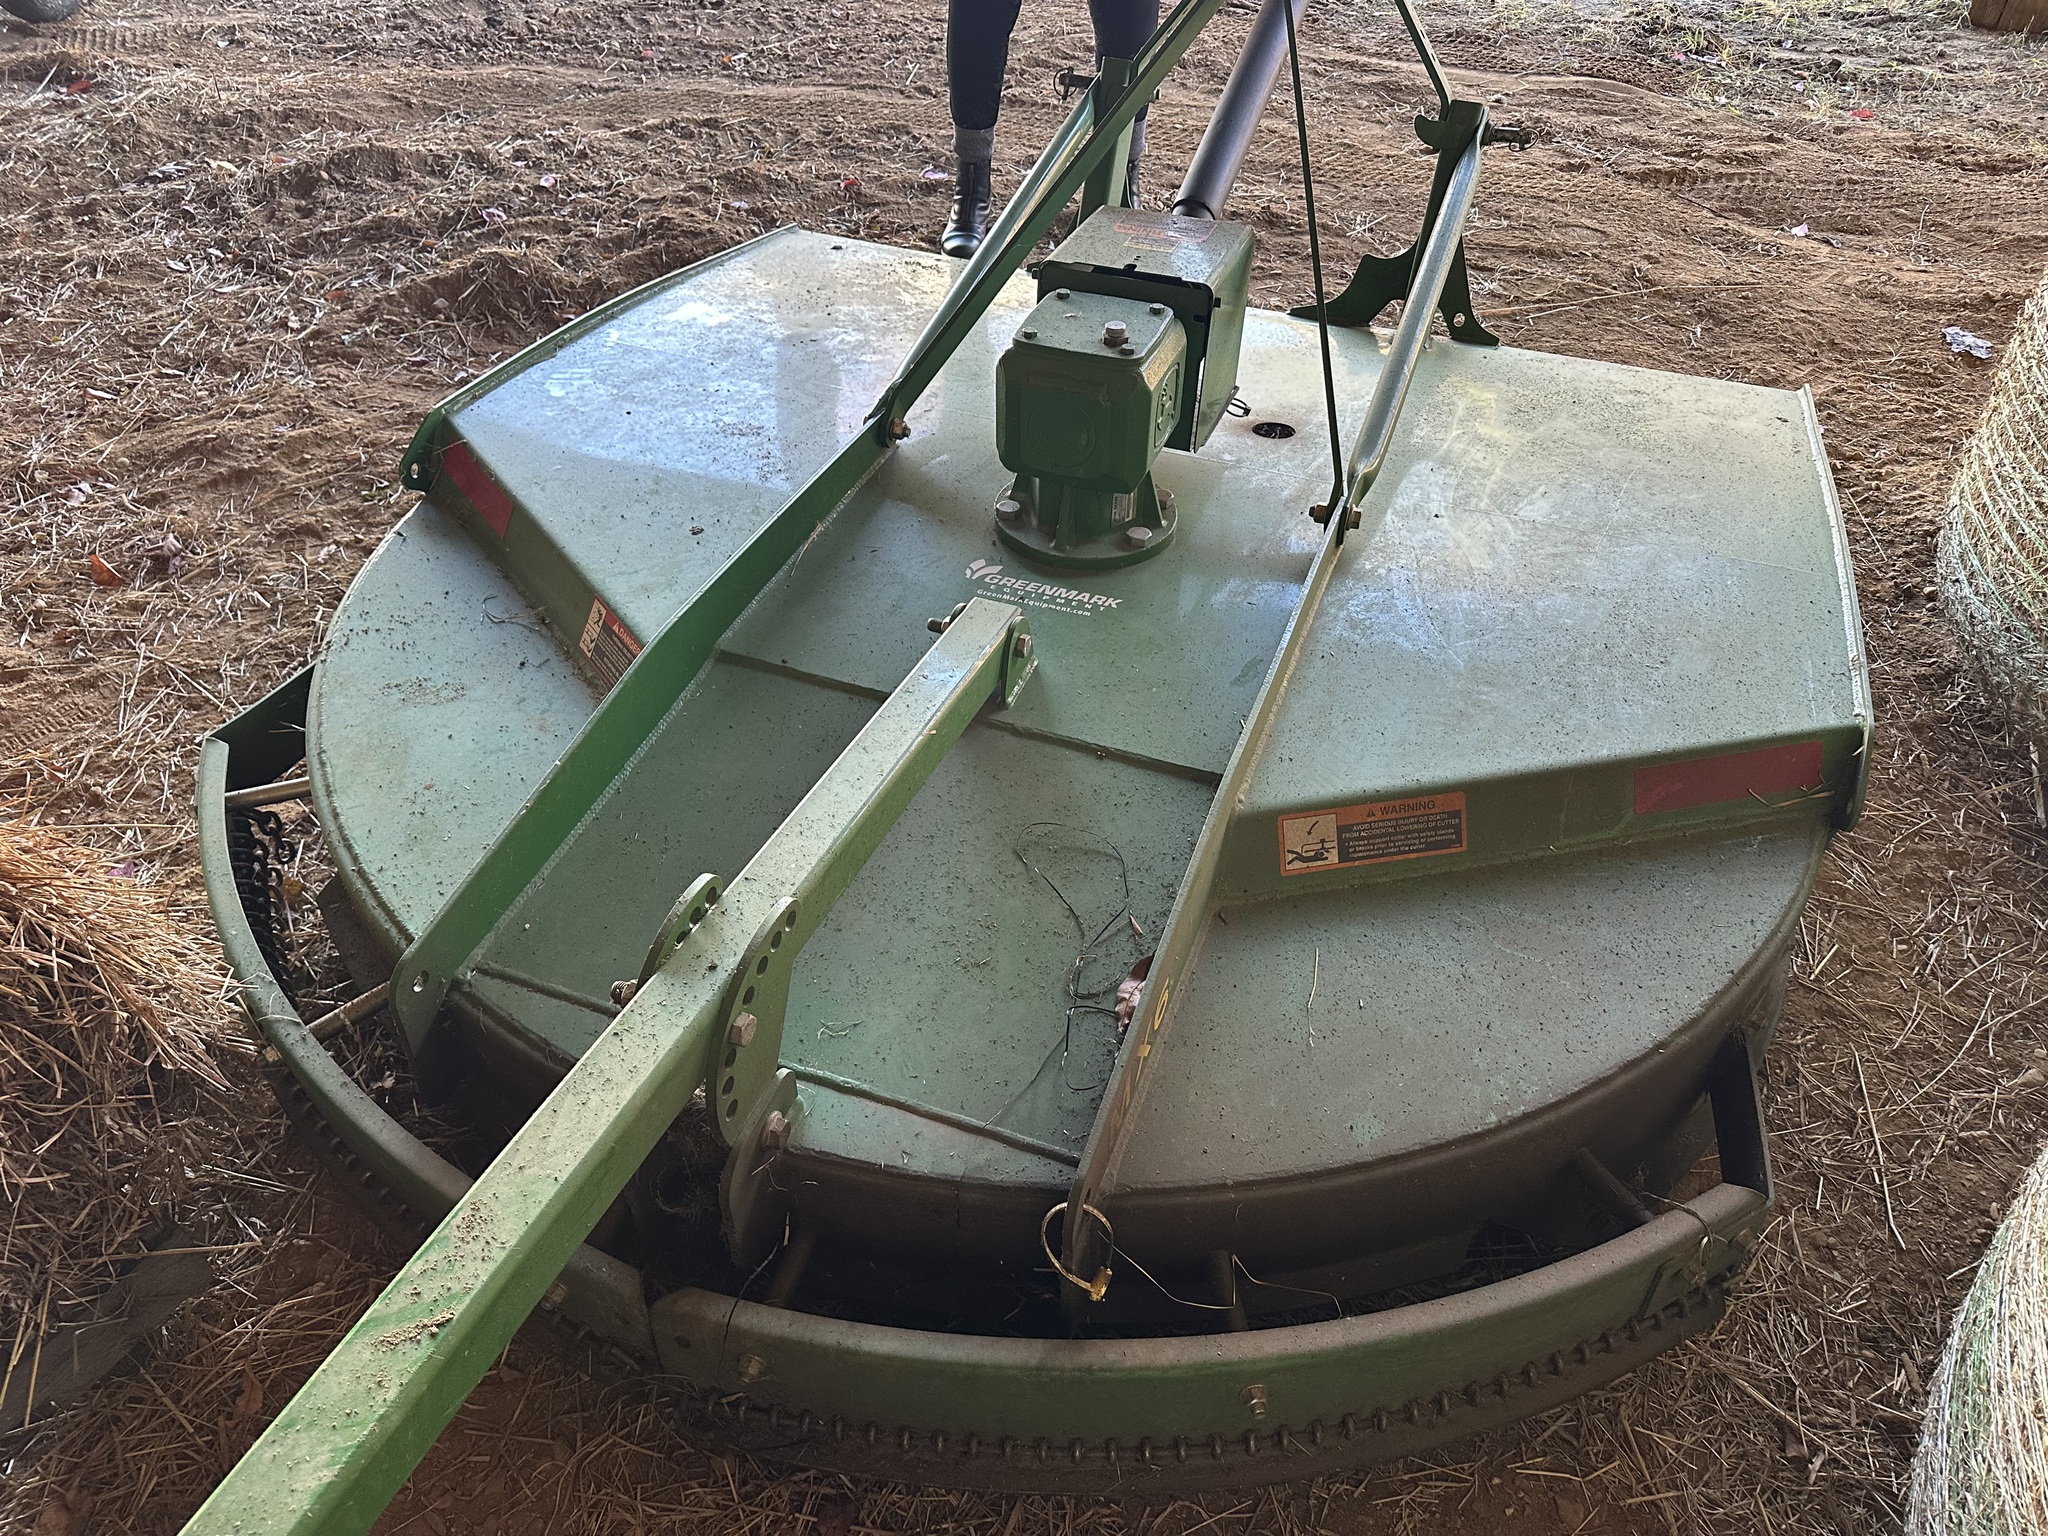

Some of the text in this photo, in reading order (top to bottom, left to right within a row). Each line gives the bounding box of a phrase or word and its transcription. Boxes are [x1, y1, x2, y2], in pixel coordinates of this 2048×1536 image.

[984, 574, 1124, 608] GREENMARK
[990, 585, 1106, 612] EQUIPMENT
[1380, 800, 1435, 816] WARNING
[1360, 828, 1395, 836] ACCIDENTAL
[1397, 823, 1427, 831] LOWERING
